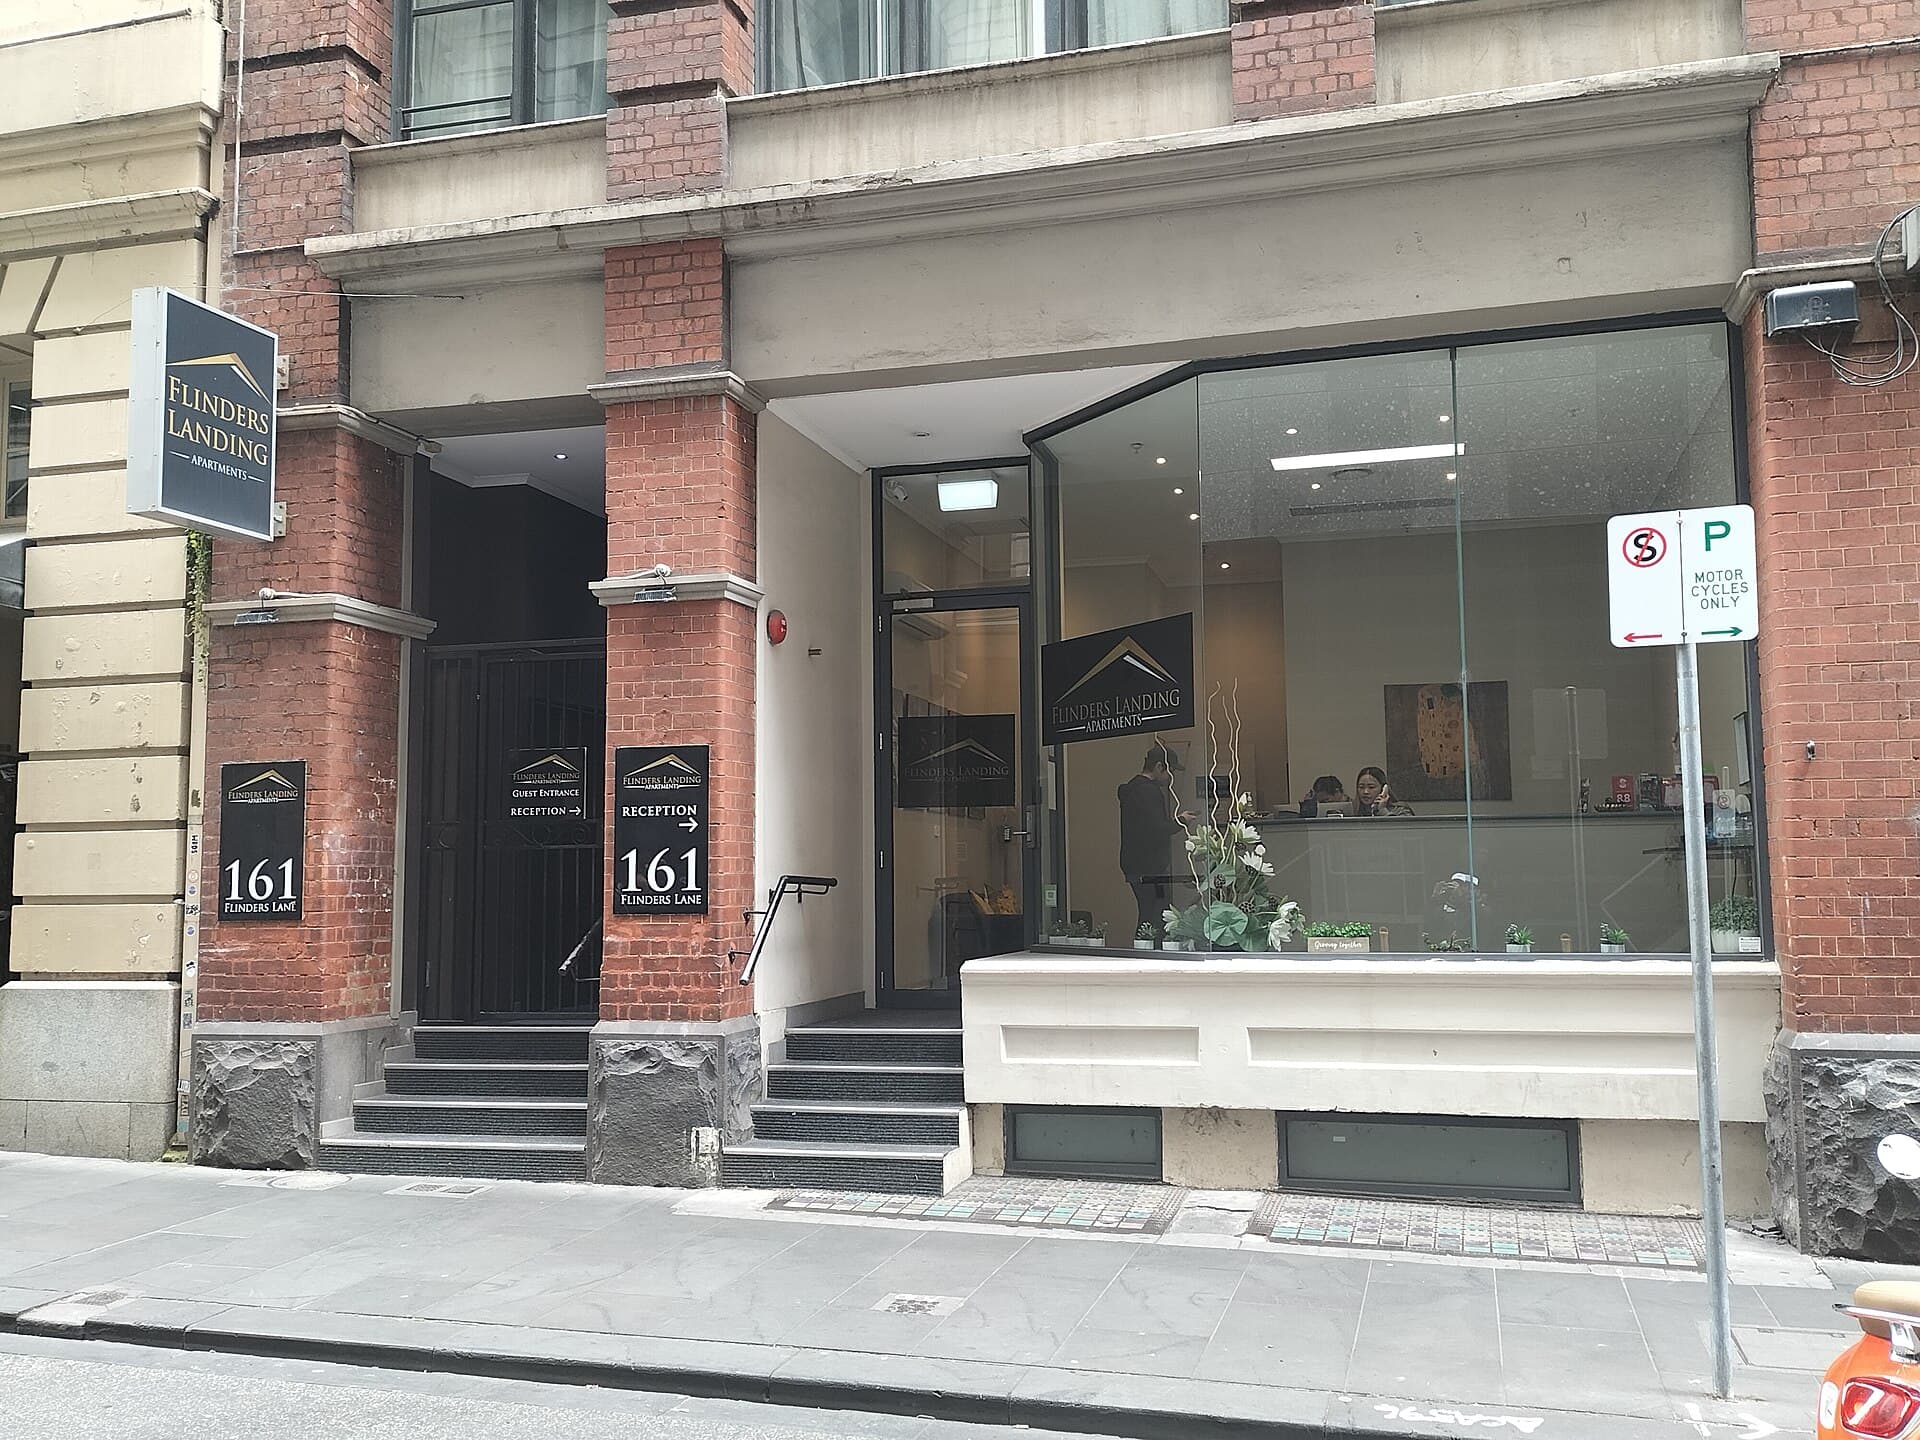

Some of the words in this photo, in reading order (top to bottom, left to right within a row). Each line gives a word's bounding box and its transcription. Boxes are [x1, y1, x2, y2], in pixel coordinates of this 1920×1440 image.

[168, 375, 269, 435] FLINDERS
[167, 409, 268, 466] LANDING
[191, 454, 247, 480] APARTMENTS
[1704, 520, 1731, 551] P
[1694, 568, 1743, 584] MOTOR
[1691, 582, 1749, 597] CYCLES
[1700, 595, 1740, 610] ONLY
[1052, 700, 1110, 725] FLINDERS
[1115, 688, 1180, 714] LANDING
[1086, 713, 1142, 733] APARTMENTS
[547, 772, 580, 780] LANDING
[959, 765, 1009, 776] LANDING
[623, 776, 661, 785] FLINDERS
[663, 775, 702, 784] LANDING
[228, 791, 263, 800] FLINDERS
[264, 790, 299, 798] LANDING
[512, 789, 538, 798] GUEST
[539, 788, 580, 797] ENTRANCE
[510, 806, 566, 816] RECEPTION
[622, 804, 697, 817] RECEPTION
[620, 847, 702, 893] 161
[224, 857, 297, 901] 161
[224, 902, 269, 913] FLINDERS
[272, 900, 297, 912] LANE
[620, 894, 671, 905] FLINDERS
[674, 893, 702, 905] LANE
